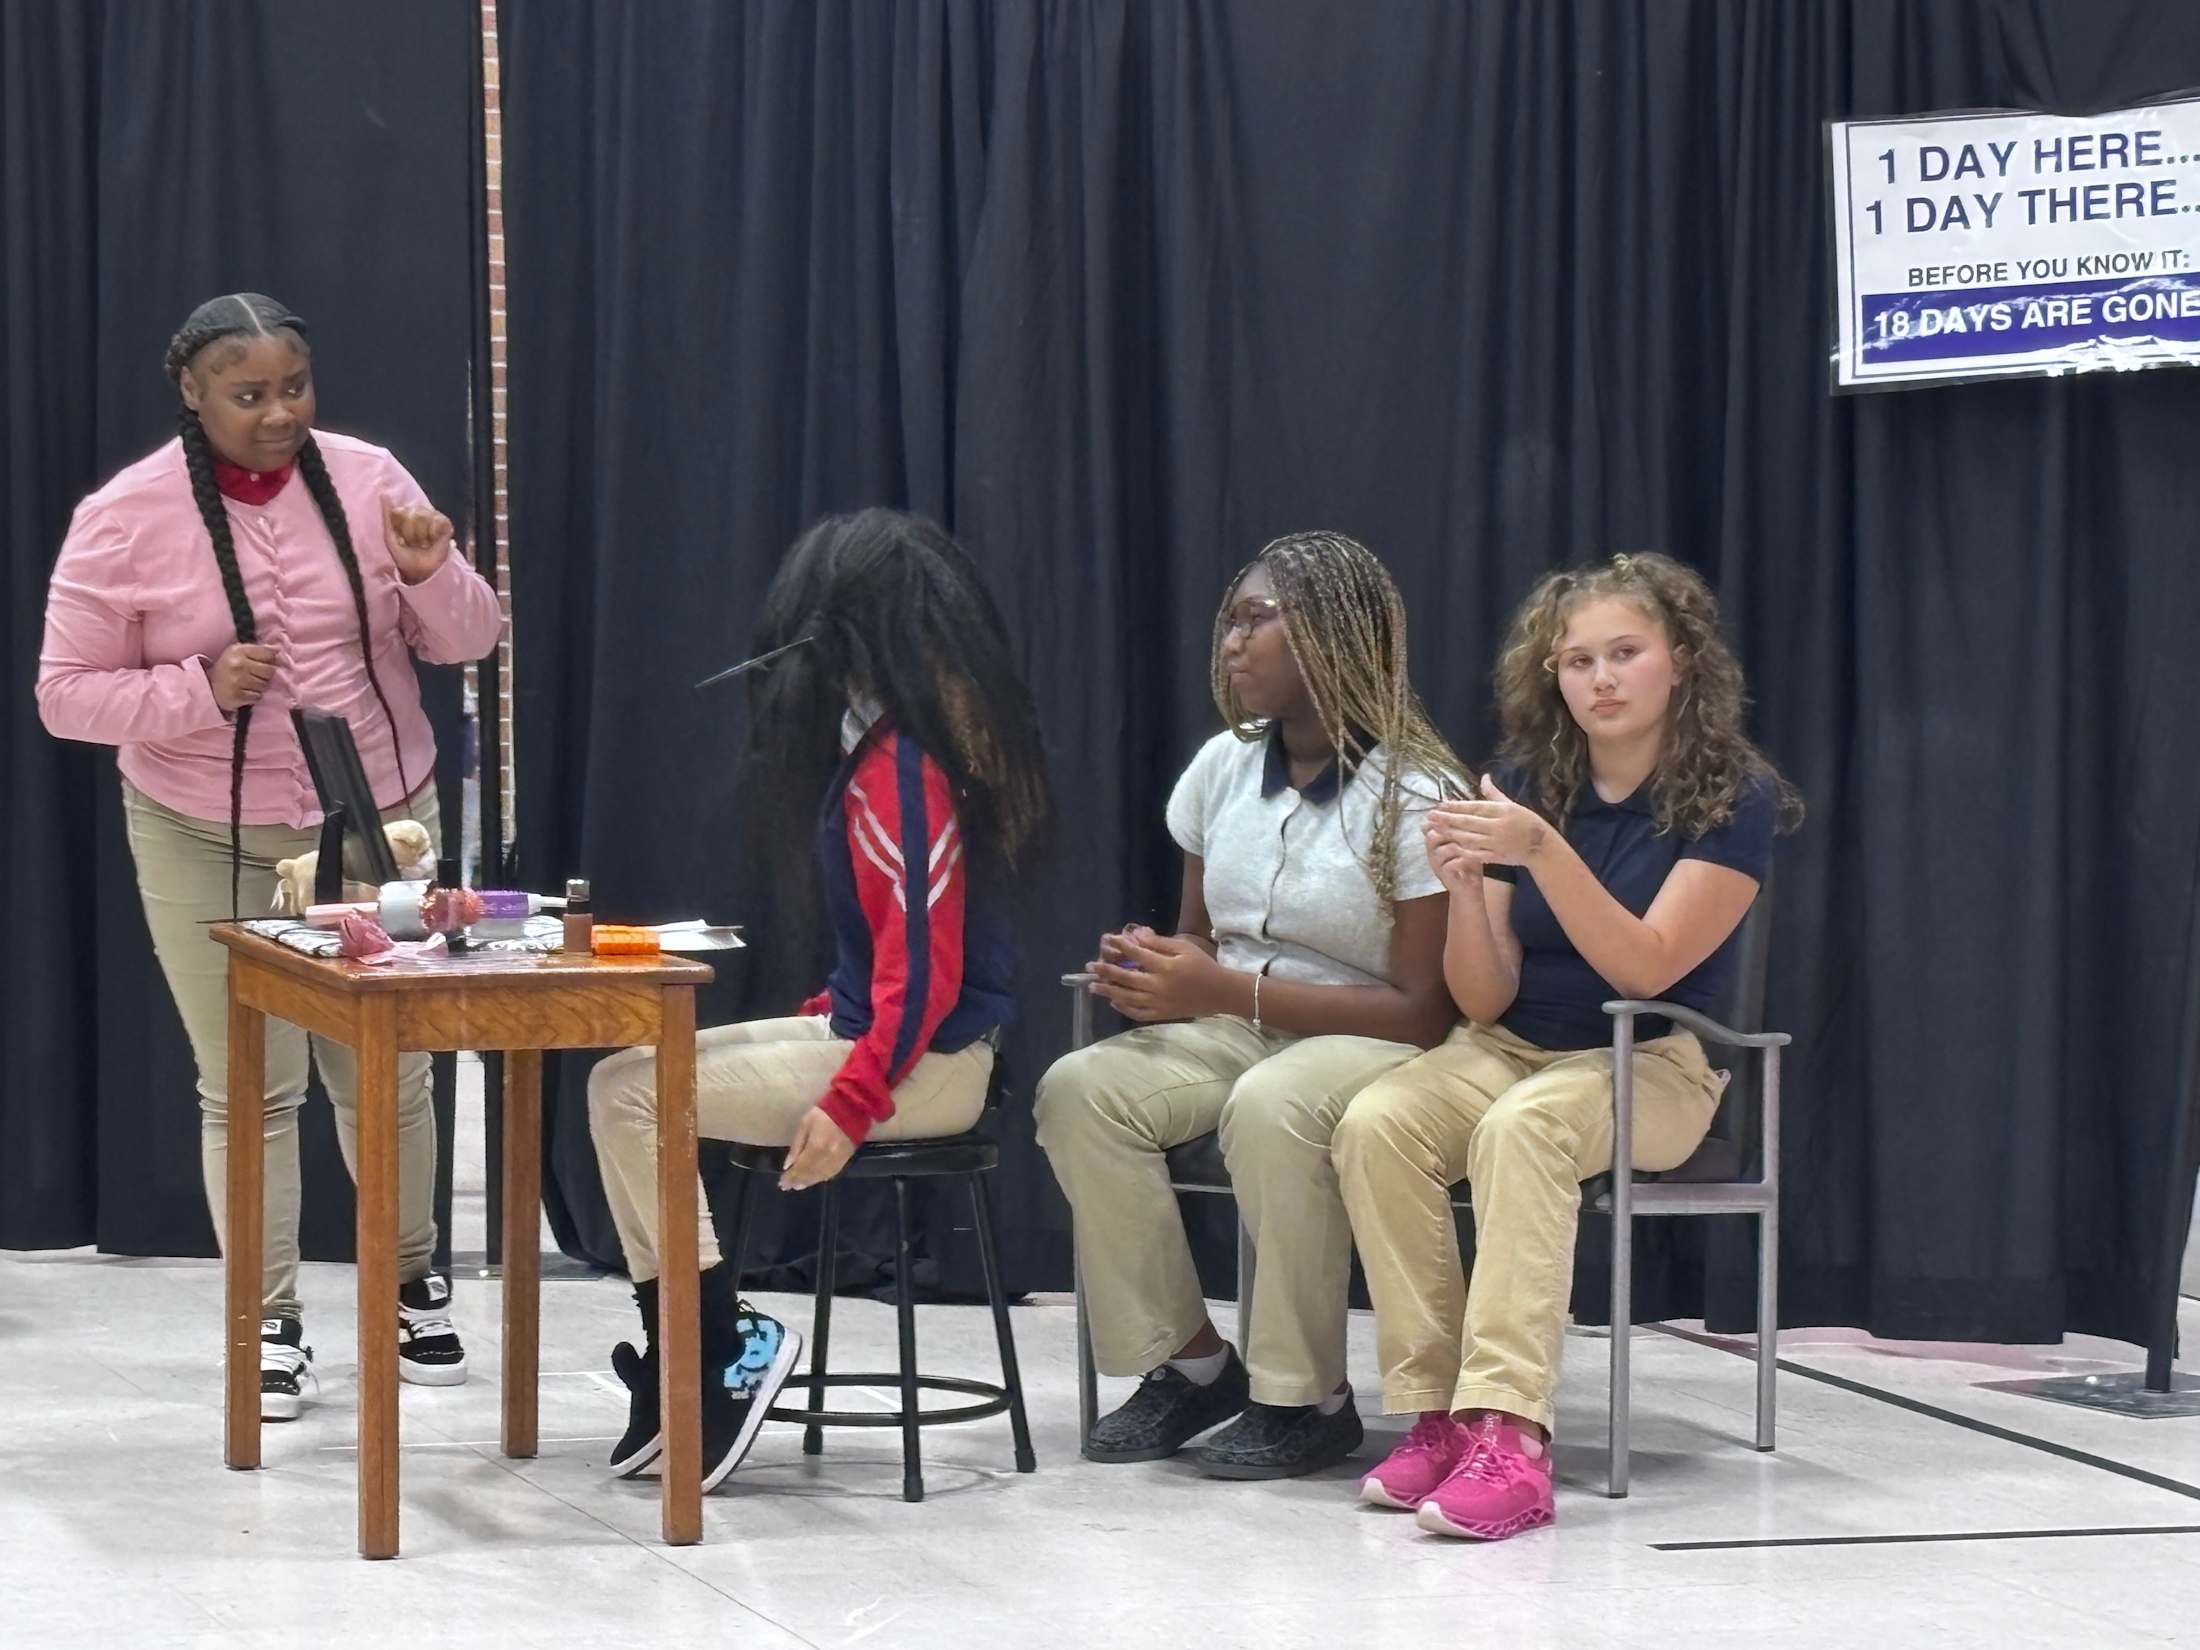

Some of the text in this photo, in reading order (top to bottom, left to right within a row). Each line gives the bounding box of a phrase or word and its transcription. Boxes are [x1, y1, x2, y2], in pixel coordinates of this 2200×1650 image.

[1878, 148, 1896, 184] 1
[1919, 140, 2018, 183] DAY
[1865, 199, 1883, 235] 1
[1906, 192, 2004, 233] DAY
[1908, 249, 2190, 287] BEFORE YOU KNOW IT:
[1873, 290, 2200, 338] 18 DAYS ARE GONE
